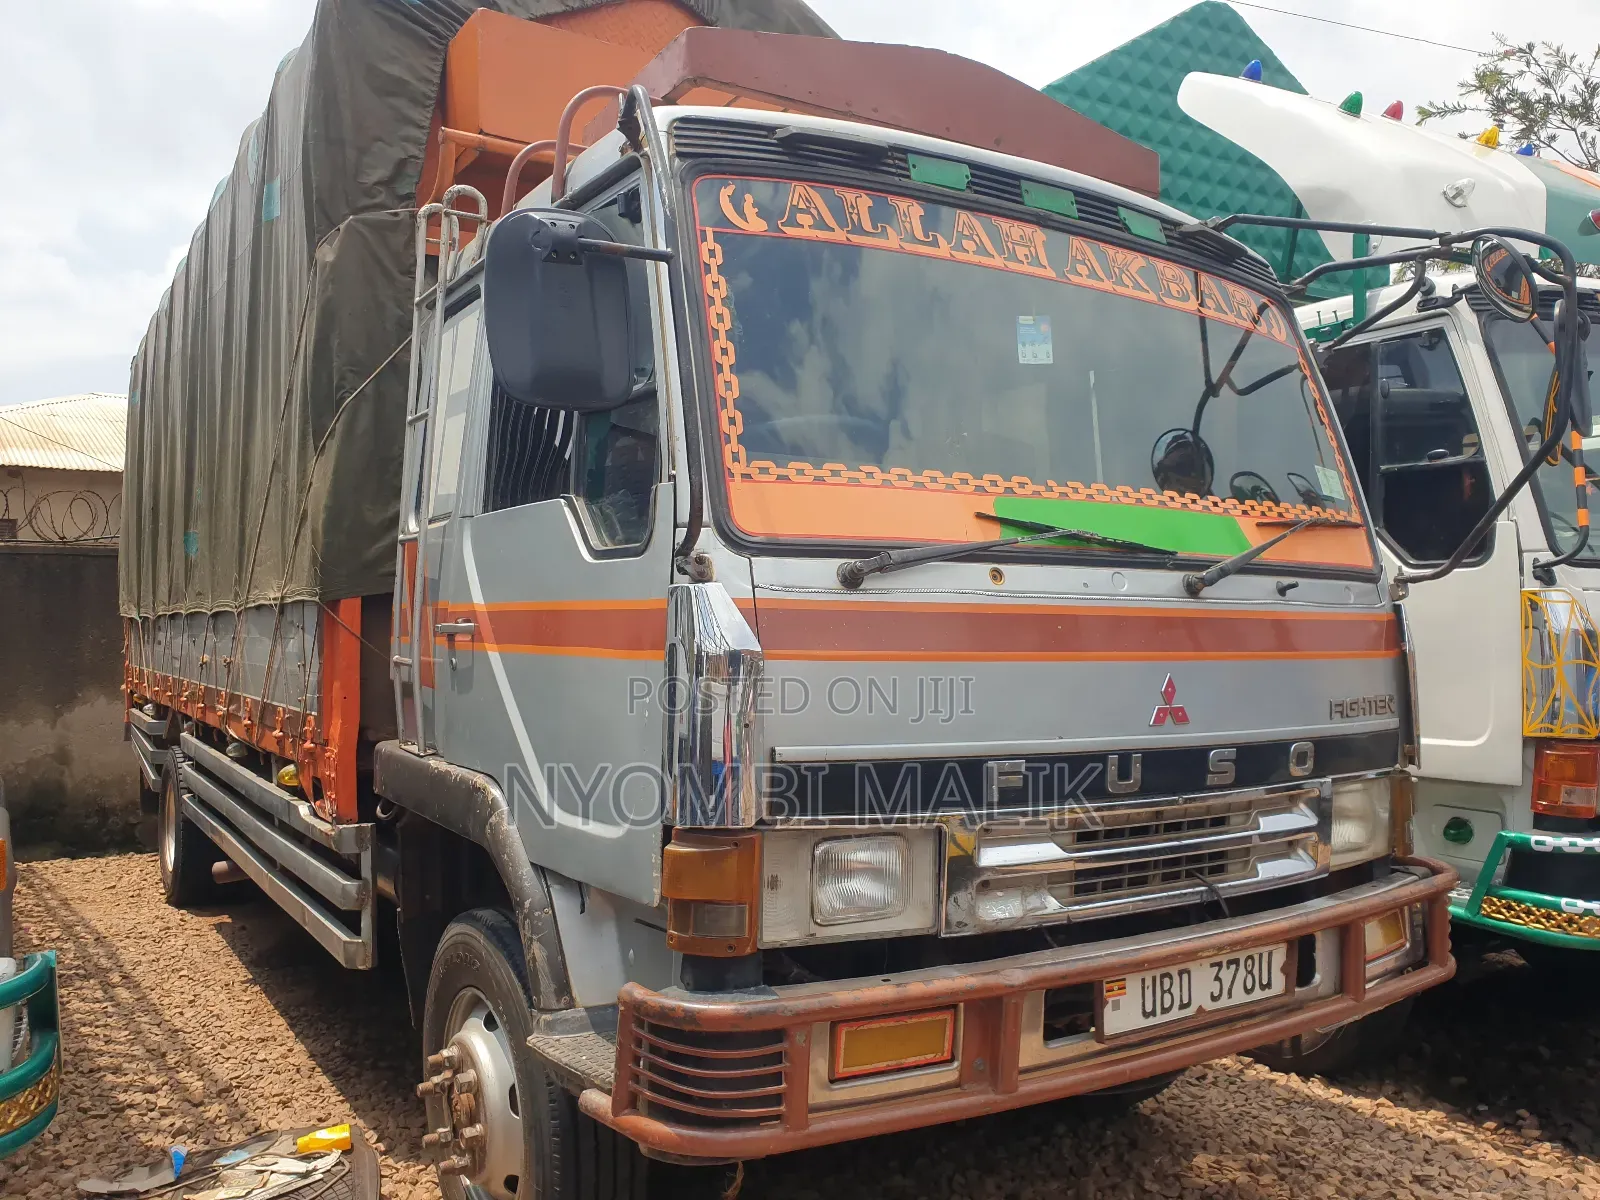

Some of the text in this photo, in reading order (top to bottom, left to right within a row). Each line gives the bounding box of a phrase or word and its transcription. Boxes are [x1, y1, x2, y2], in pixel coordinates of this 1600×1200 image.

[778, 183, 1267, 334] ALLAH AKBAR
[1329, 694, 1395, 720] FIGHTER
[987, 741, 1315, 802] FUSO
[1141, 950, 1274, 1020] UBD 378U
